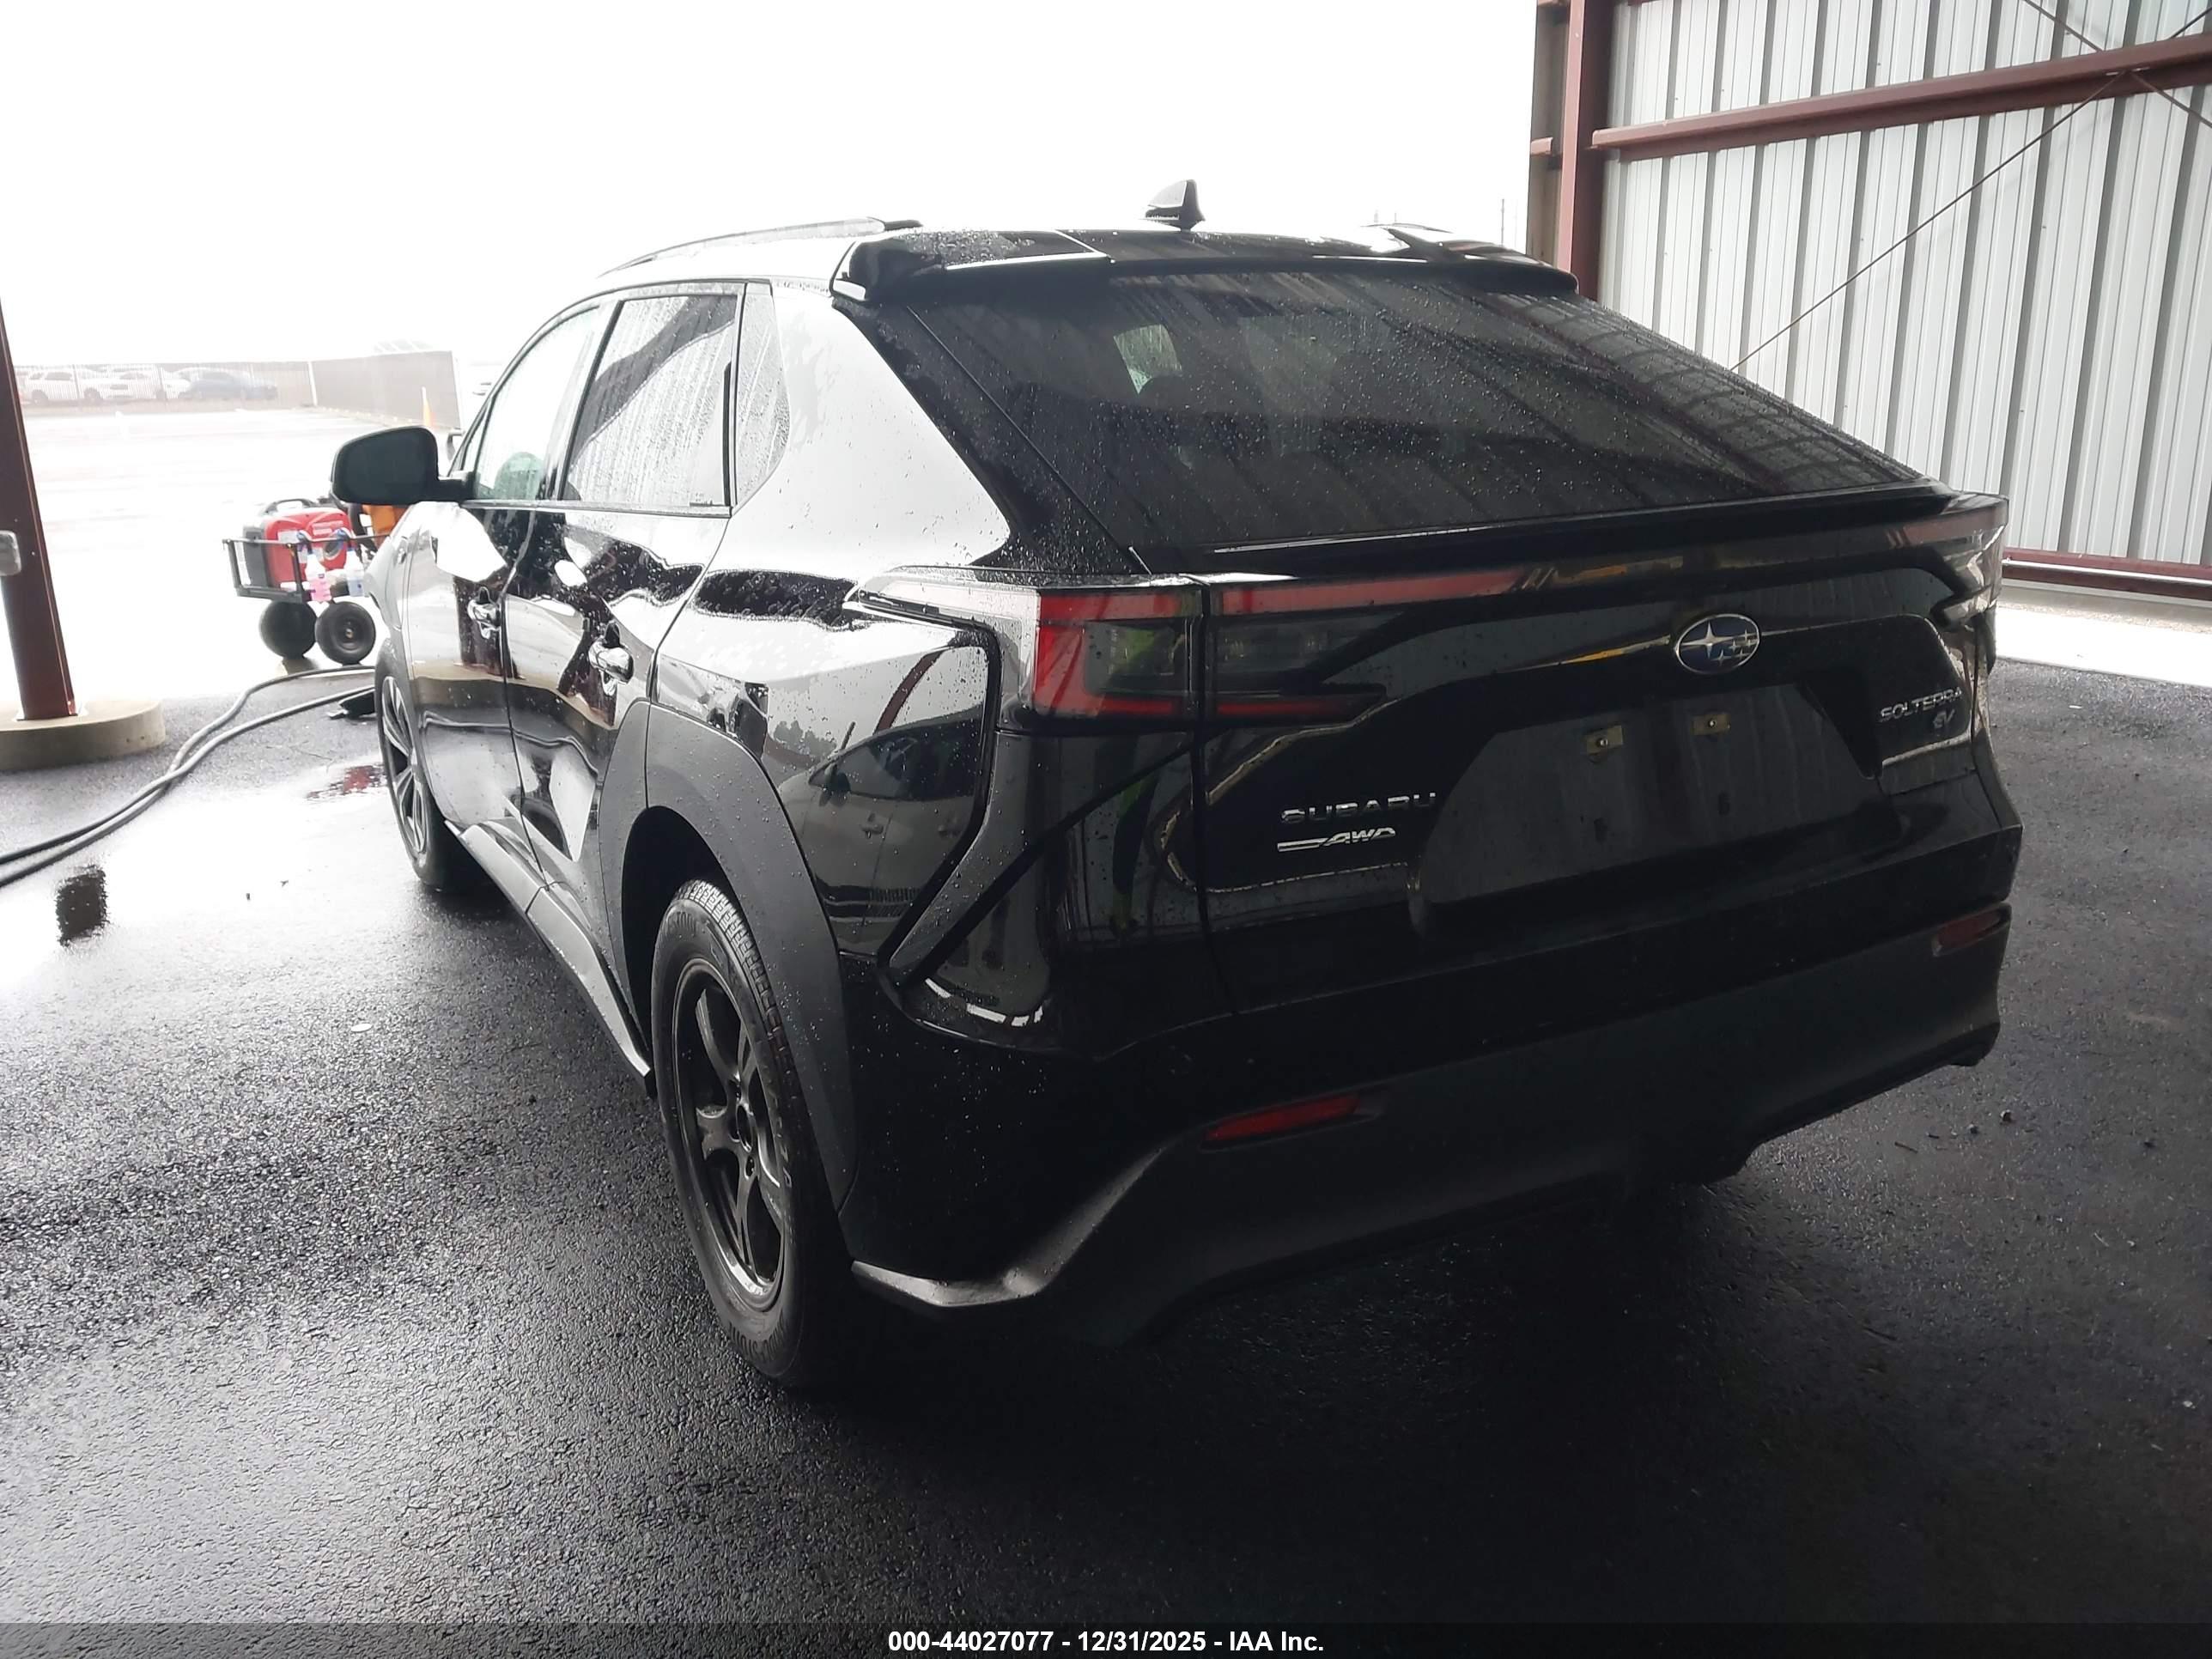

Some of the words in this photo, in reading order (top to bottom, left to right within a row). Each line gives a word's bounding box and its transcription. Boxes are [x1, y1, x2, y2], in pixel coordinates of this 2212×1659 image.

[1878, 687, 1962, 722] SOLTERRA
[1933, 708, 1955, 728] EV
[1280, 791, 1437, 823] SUBARU
